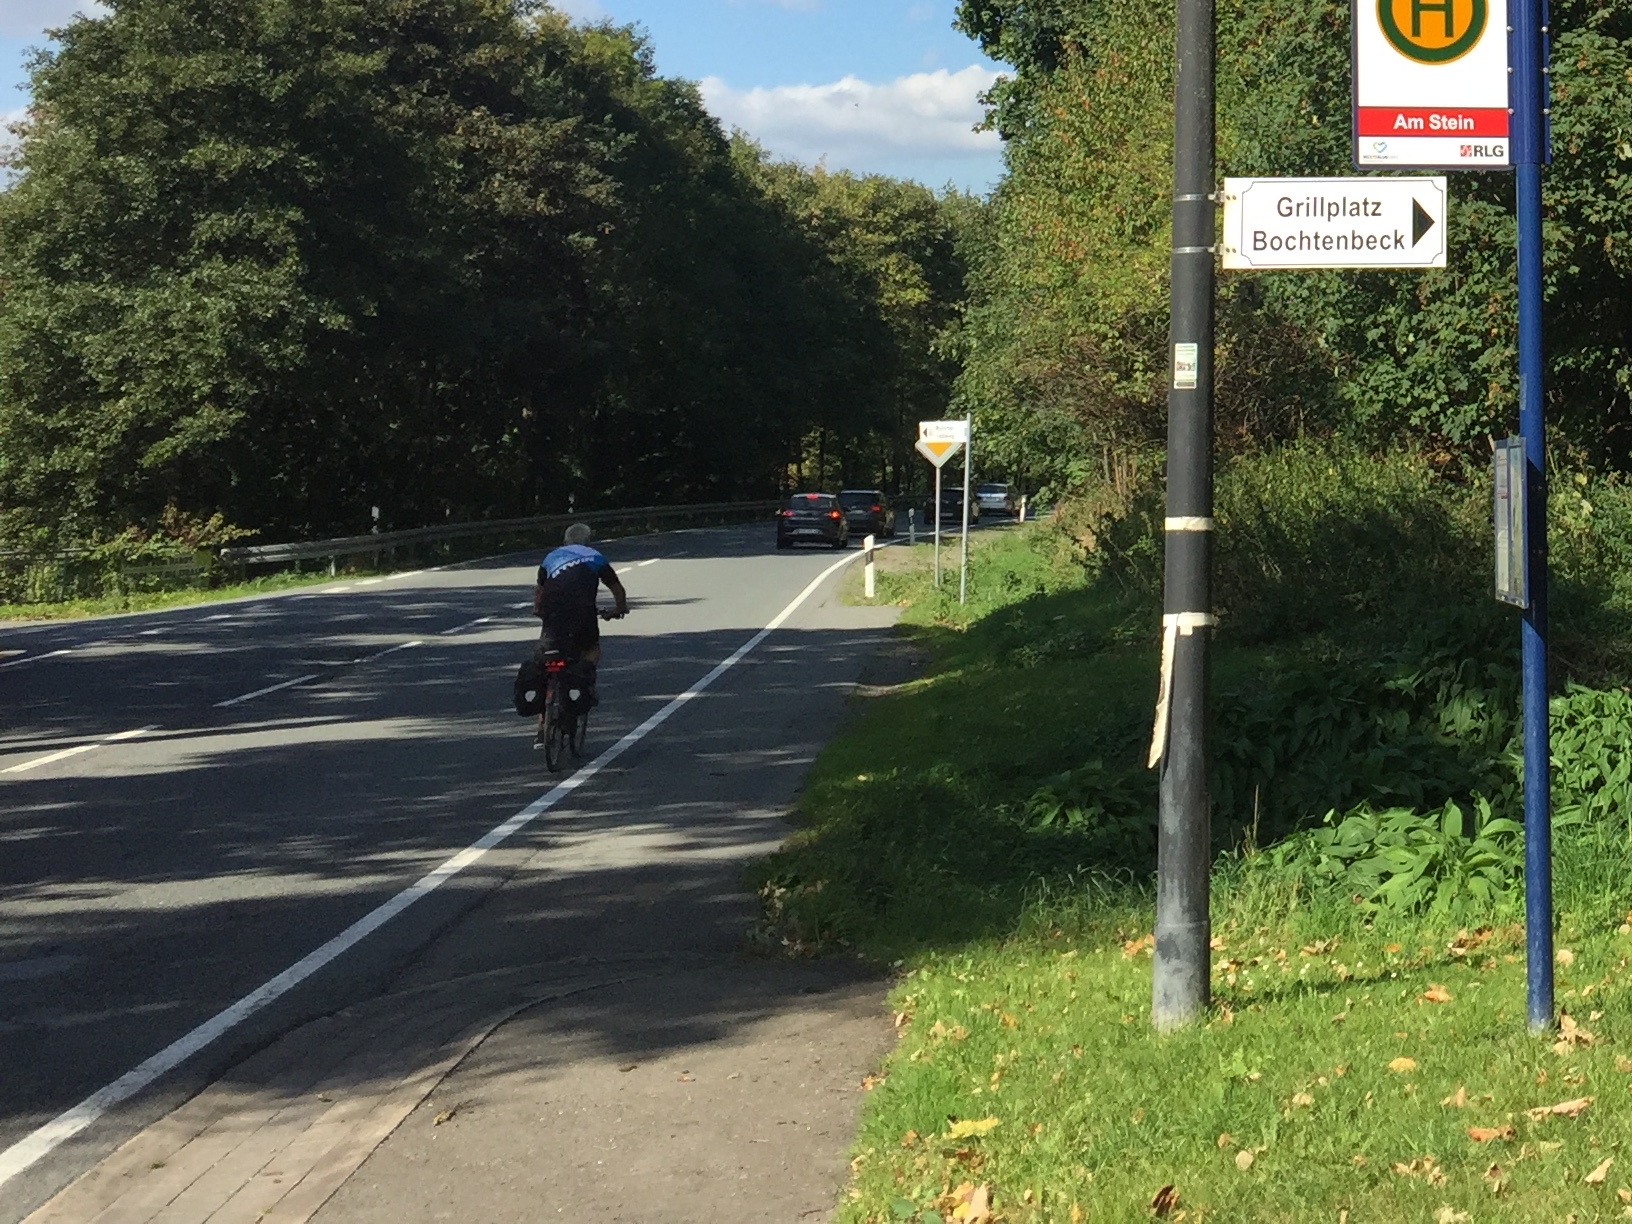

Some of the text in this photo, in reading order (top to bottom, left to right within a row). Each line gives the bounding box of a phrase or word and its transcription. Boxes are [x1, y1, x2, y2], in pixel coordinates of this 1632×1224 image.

[1393, 114, 1475, 130] Am Stein
[1473, 144, 1504, 158] RLG
[1277, 196, 1382, 222] Grillplatz
[1253, 229, 1405, 251] Bochtenbeck
